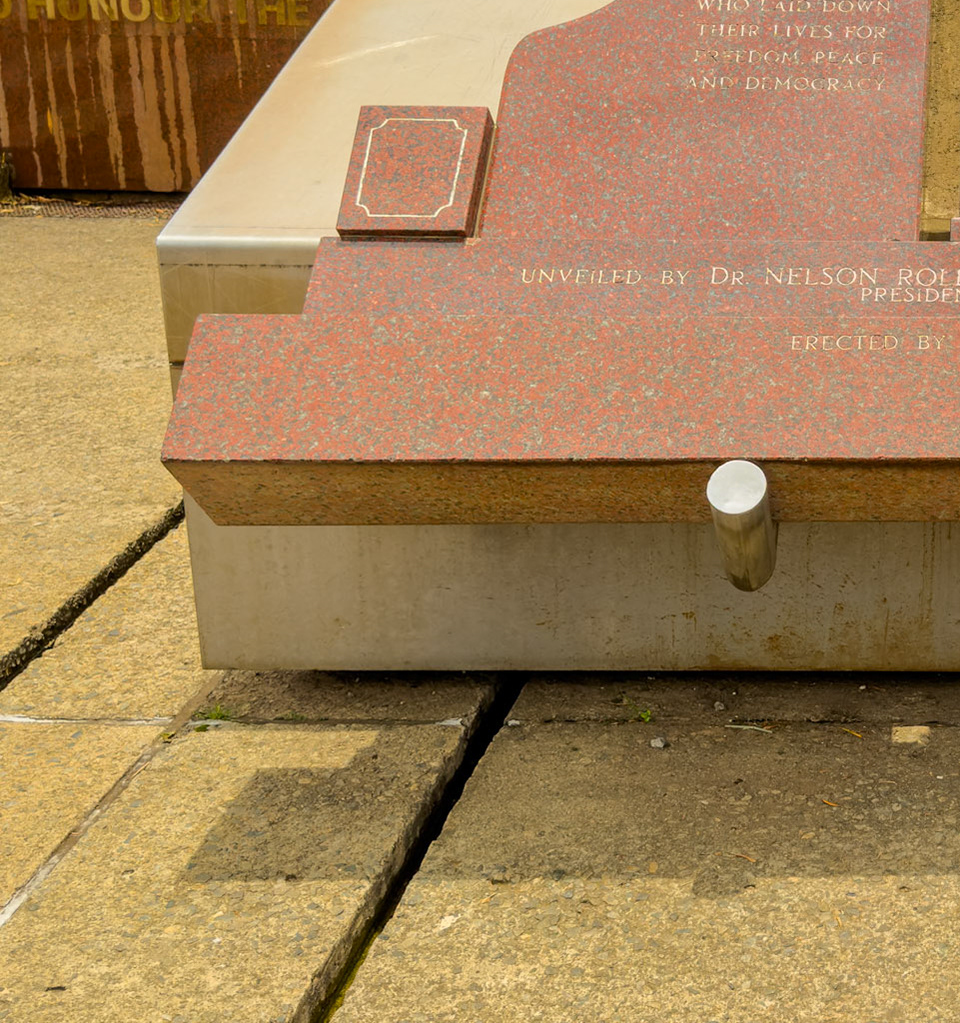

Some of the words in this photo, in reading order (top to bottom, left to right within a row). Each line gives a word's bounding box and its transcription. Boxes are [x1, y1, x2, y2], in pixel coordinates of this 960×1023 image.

[761, 0, 811, 13] LAID
[822, 0, 891, 14] DOWN
[698, 24, 759, 38] THEIR
[774, 24, 833, 39] LIVES
[845, 25, 886, 39] FOR
[815, 51, 884, 66] PEACE
[686, 76, 734, 89] AND
[745, 76, 886, 91] DEMOCRACY
[520, 268, 642, 285] UNVEILED
[660, 269, 690, 286] BY
[765, 267, 879, 287] NELSON
[791, 335, 899, 351] ERECTED
[917, 335, 945, 351] BY
